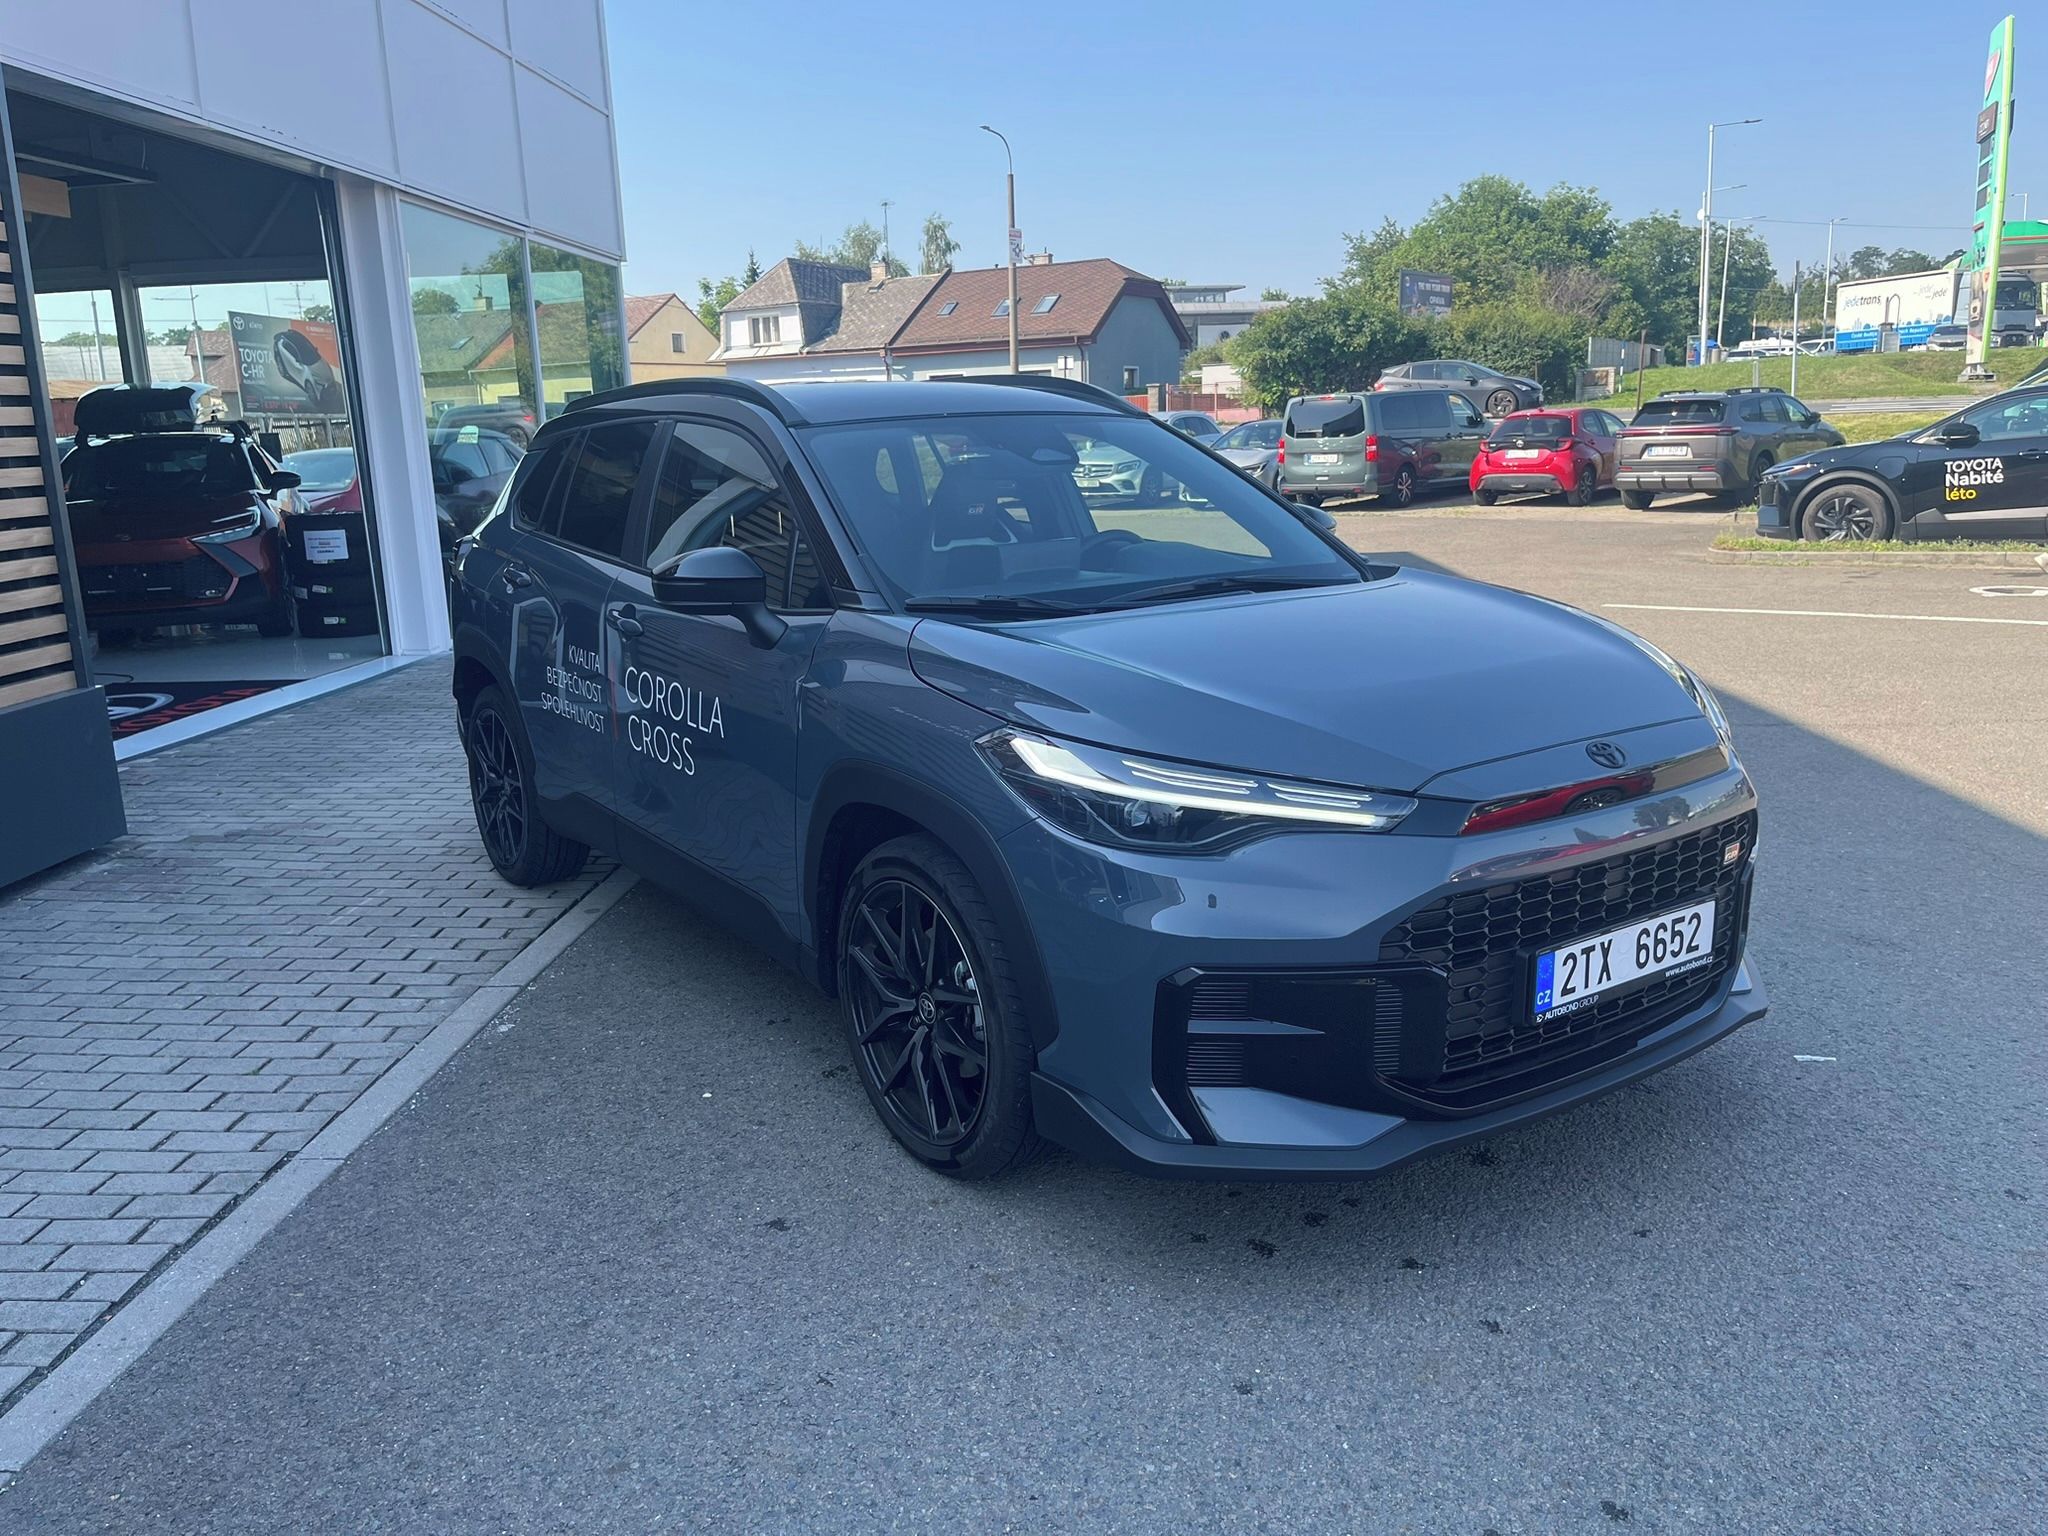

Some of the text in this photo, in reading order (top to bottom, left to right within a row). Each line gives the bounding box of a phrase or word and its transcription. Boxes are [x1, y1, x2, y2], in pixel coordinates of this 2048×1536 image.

[238, 348, 274, 364] TOYOTA
[241, 363, 266, 378] C-HR
[1944, 457, 2003, 473] TOYOTA
[1945, 469, 2004, 487] Nabité
[1945, 487, 1977, 501] léto
[568, 644, 601, 673] KVALITA
[546, 665, 602, 704] BEZPEČNOST
[625, 666, 725, 738] COROLLA
[628, 714, 695, 776] CROSS
[1560, 911, 1702, 998] 2TX 6652
[1665, 956, 1713, 978] www.autobond.cz
[1536, 989, 1551, 1006] CZ
[1544, 995, 1599, 1021] AUTOBOND GROUP
